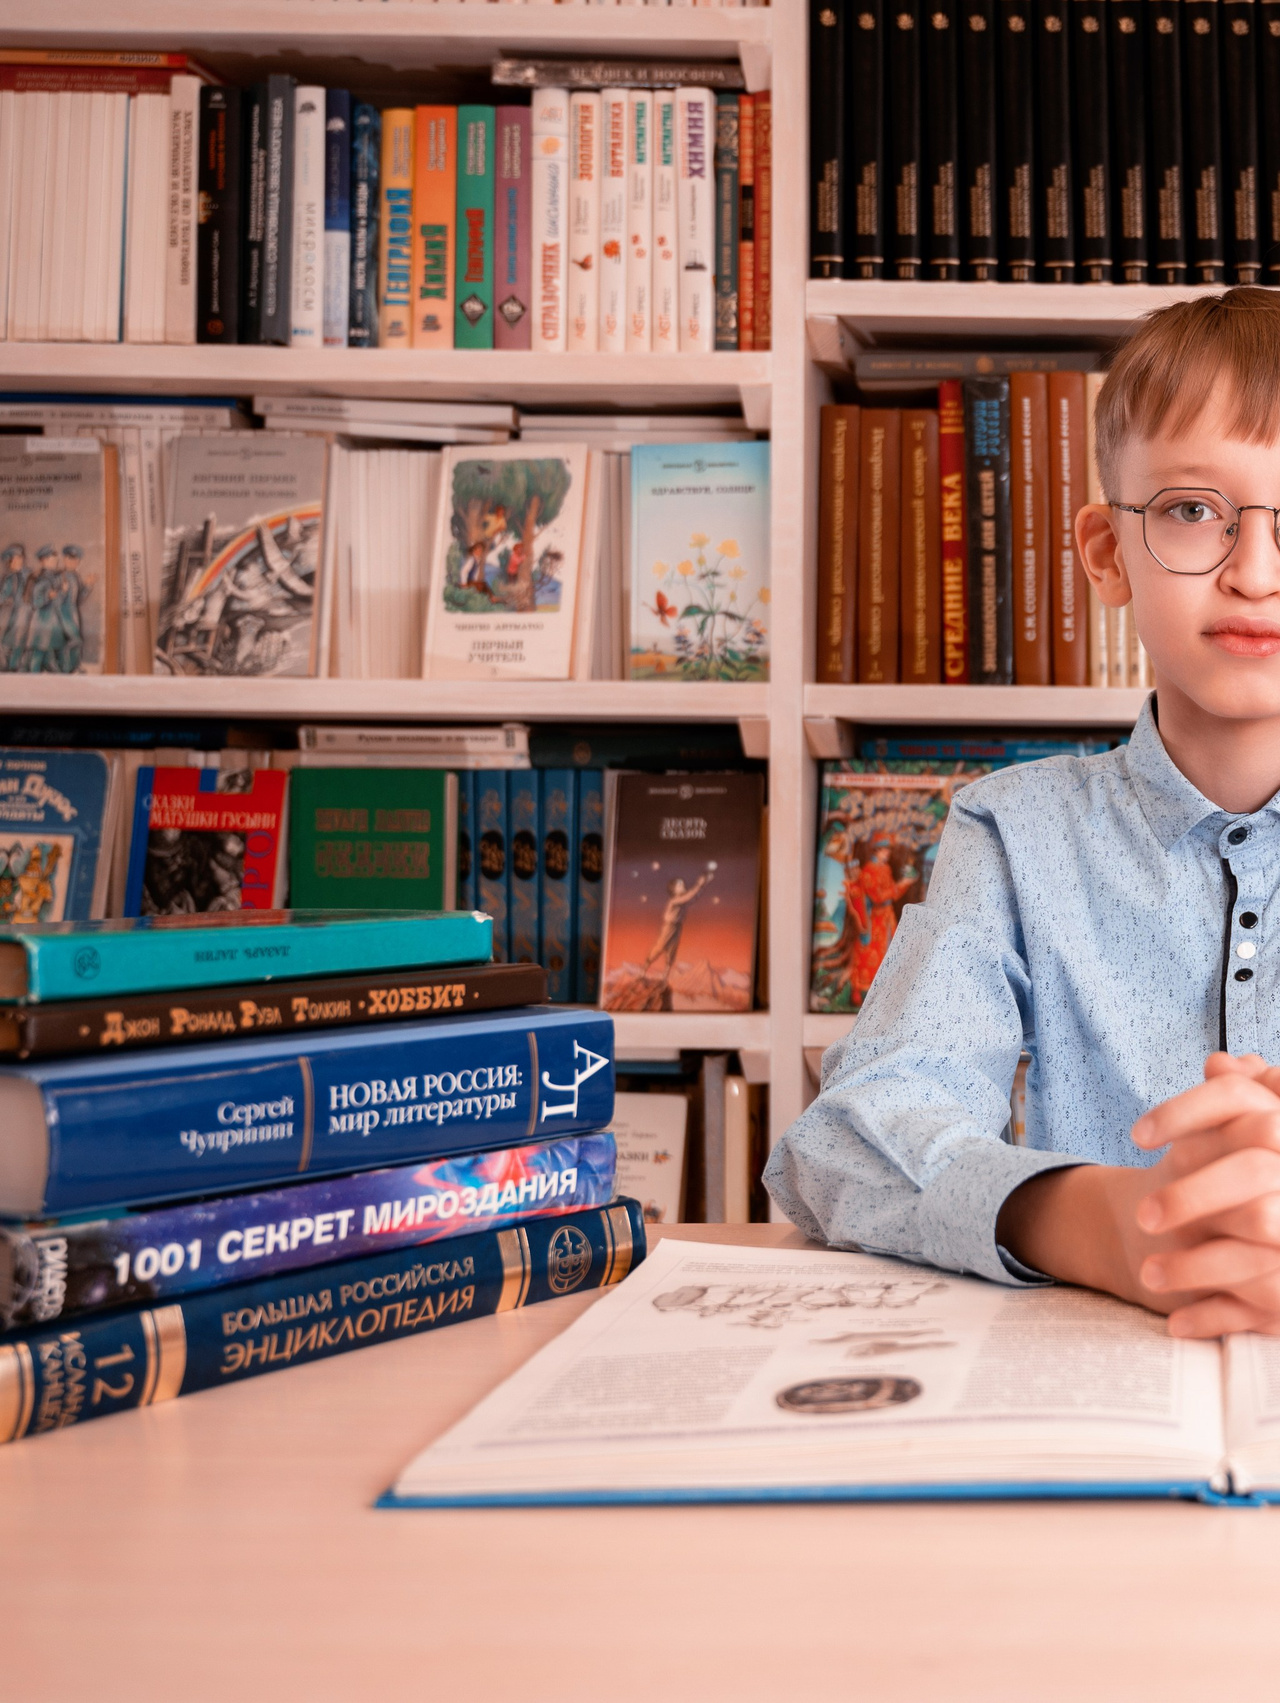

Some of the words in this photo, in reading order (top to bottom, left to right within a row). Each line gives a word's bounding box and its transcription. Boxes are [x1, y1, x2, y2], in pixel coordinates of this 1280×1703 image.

[579, 104, 594, 181] ЗООЛОГИЯ
[609, 102, 625, 178] БОТАНИКА
[687, 101, 706, 181] ХИМИЯ
[384, 188, 412, 307] ГЕОГРАФИЯ
[419, 224, 448, 300] ХИМИЯ
[541, 243, 559, 341] СПРАВОЧНИК
[941, 472, 961, 541] ВЕКА
[977, 470, 996, 517] ДЕТЕЙ
[981, 520, 996, 551] ДЛЯ
[1024, 549, 1036, 615] СОЛОВЬЕВ
[1062, 549, 1074, 615] СОЛОВЬЕВ
[943, 559, 966, 677] СРЕДНИЕ
[981, 555, 997, 673] ЭНЦИКЛОПЕДИЯ
[468, 652, 526, 663] УЧИТЕЛЬ
[472, 640, 523, 650] ПЕРВЫЙ
[142, 793, 196, 811] СКАЗКИ
[151, 810, 219, 828] МАТУШКИ
[220, 811, 277, 829] ГУСЫНИ
[662, 817, 708, 830] ДЕСЯТЬ
[661, 828, 706, 839] СКАЗОК
[194, 949, 239, 964] ЛАГИН
[243, 945, 292, 960] ЛАЗАРЬ
[368, 984, 467, 1015] ХОББИТ
[217, 1094, 295, 1126] Сергей
[329, 1112, 380, 1137] мир
[384, 1090, 519, 1129] литературы
[330, 1077, 419, 1112] НОВАЯ
[423, 1063, 524, 1100] РОССИЯ:
[180, 1120, 295, 1159] Чупринин
[115, 1239, 203, 1285] 1001
[217, 1207, 355, 1265] СЕКРЕТ
[363, 1166, 579, 1237] МИРОЗДАНИЯ
[222, 1288, 333, 1337] БОЛЬШАЯ
[340, 1255, 476, 1305] РОССИЙСКАЯ
[222, 1284, 476, 1376] ЭНЦИКЛОПЕДИЯ
[93, 1343, 136, 1405] 12
